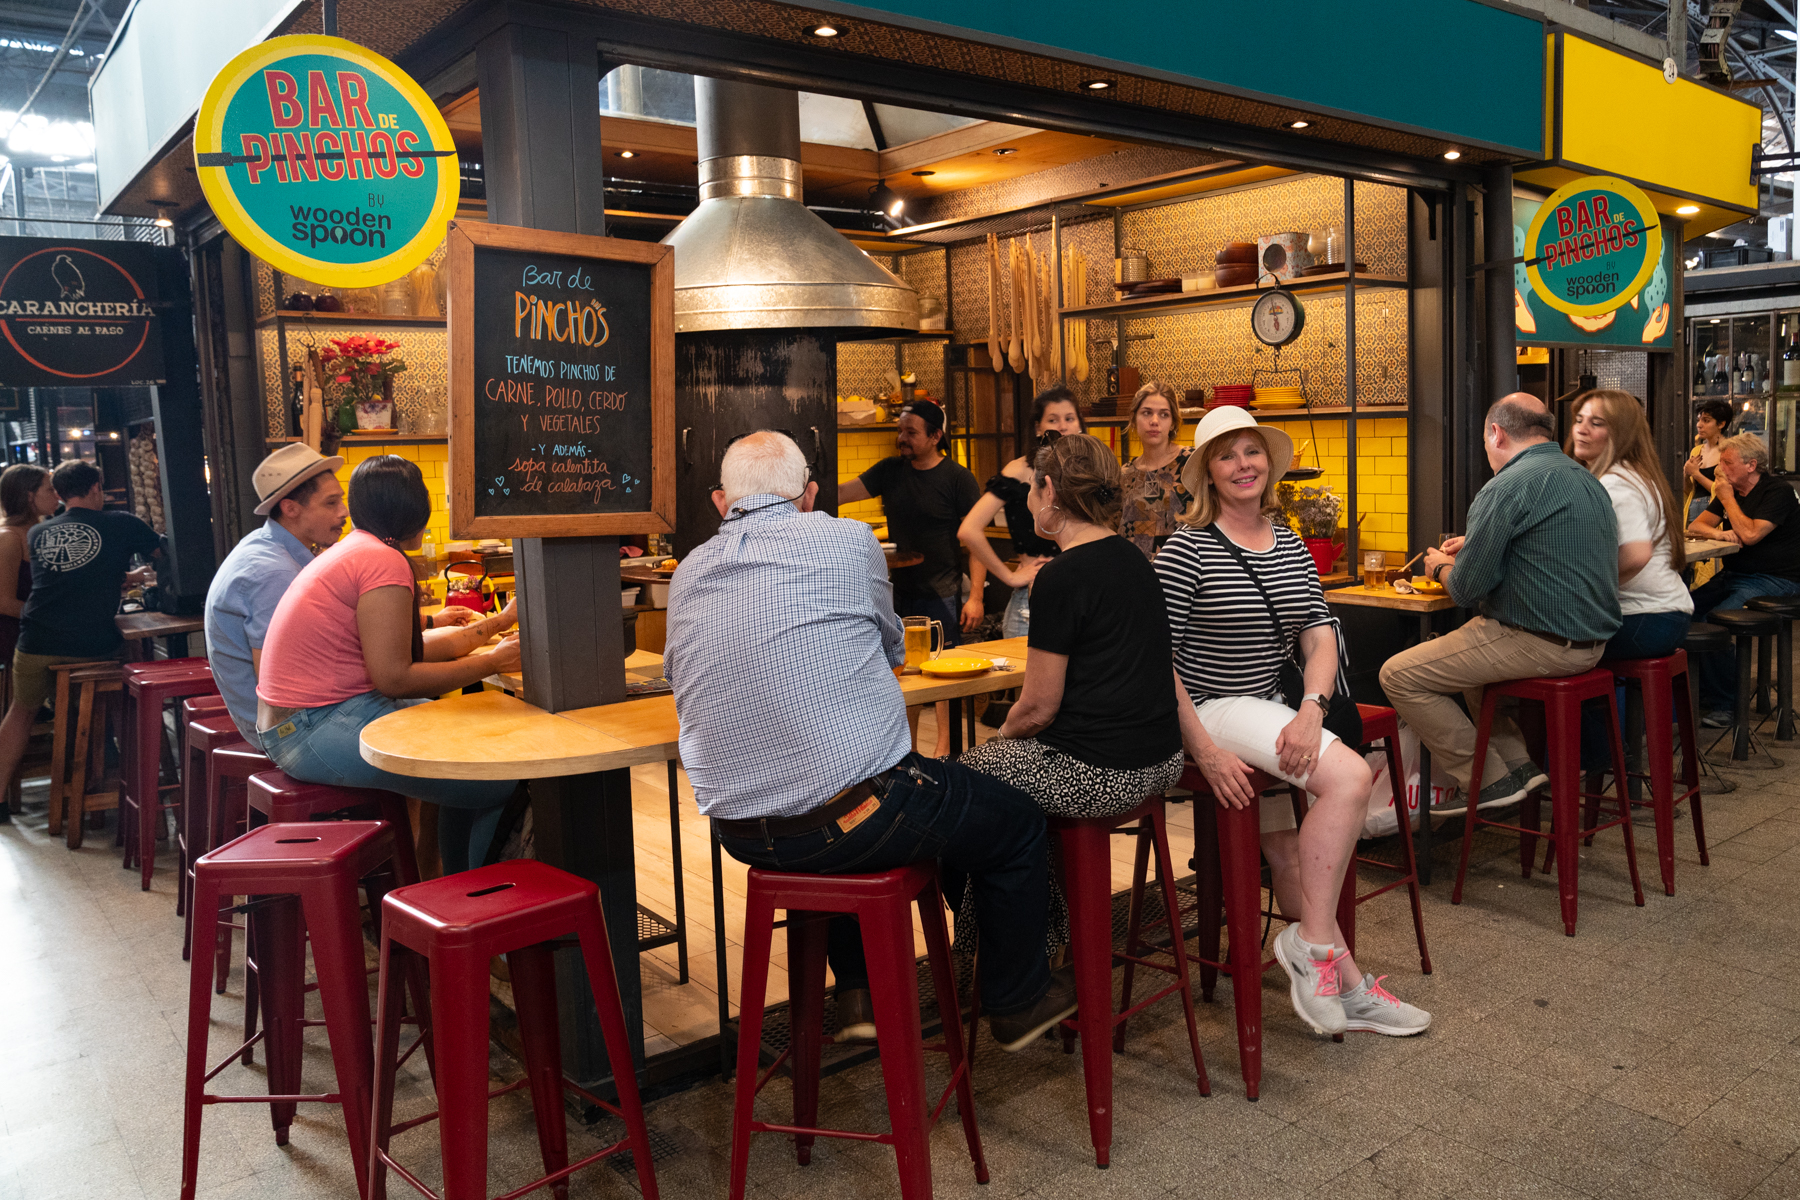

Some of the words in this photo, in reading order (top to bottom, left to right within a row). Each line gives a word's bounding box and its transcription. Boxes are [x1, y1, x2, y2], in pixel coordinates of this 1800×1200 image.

[264, 70, 376, 128] BAR
[379, 114, 399, 129] DE
[240, 130, 425, 184] PINCHOS
[290, 205, 391, 230] wooden
[1556, 195, 1611, 238] BAR
[1613, 212, 1625, 223] DE
[292, 222, 386, 249] spoon
[1544, 220, 1639, 271] PINCHOS
[523, 265, 562, 288] Bar
[568, 267, 595, 290] de
[1566, 271, 1619, 286] wooden
[1566, 281, 1616, 299] spoon
[27, 326, 72, 334] CARNES
[77, 326, 91, 334] AL
[95, 326, 124, 335] PASO
[505, 354, 555, 378] TENEMOS
[560, 360, 600, 381] PINCHOS
[605, 366, 616, 381] DE
[589, 390, 628, 411] CERDO
[521, 414, 529, 431] Y
[540, 414, 600, 434] VEGETALES
[508, 458, 546, 481] sopa
[552, 458, 611, 475] calentita
[520, 476, 541, 493] de
[548, 478, 616, 504] calabaza
